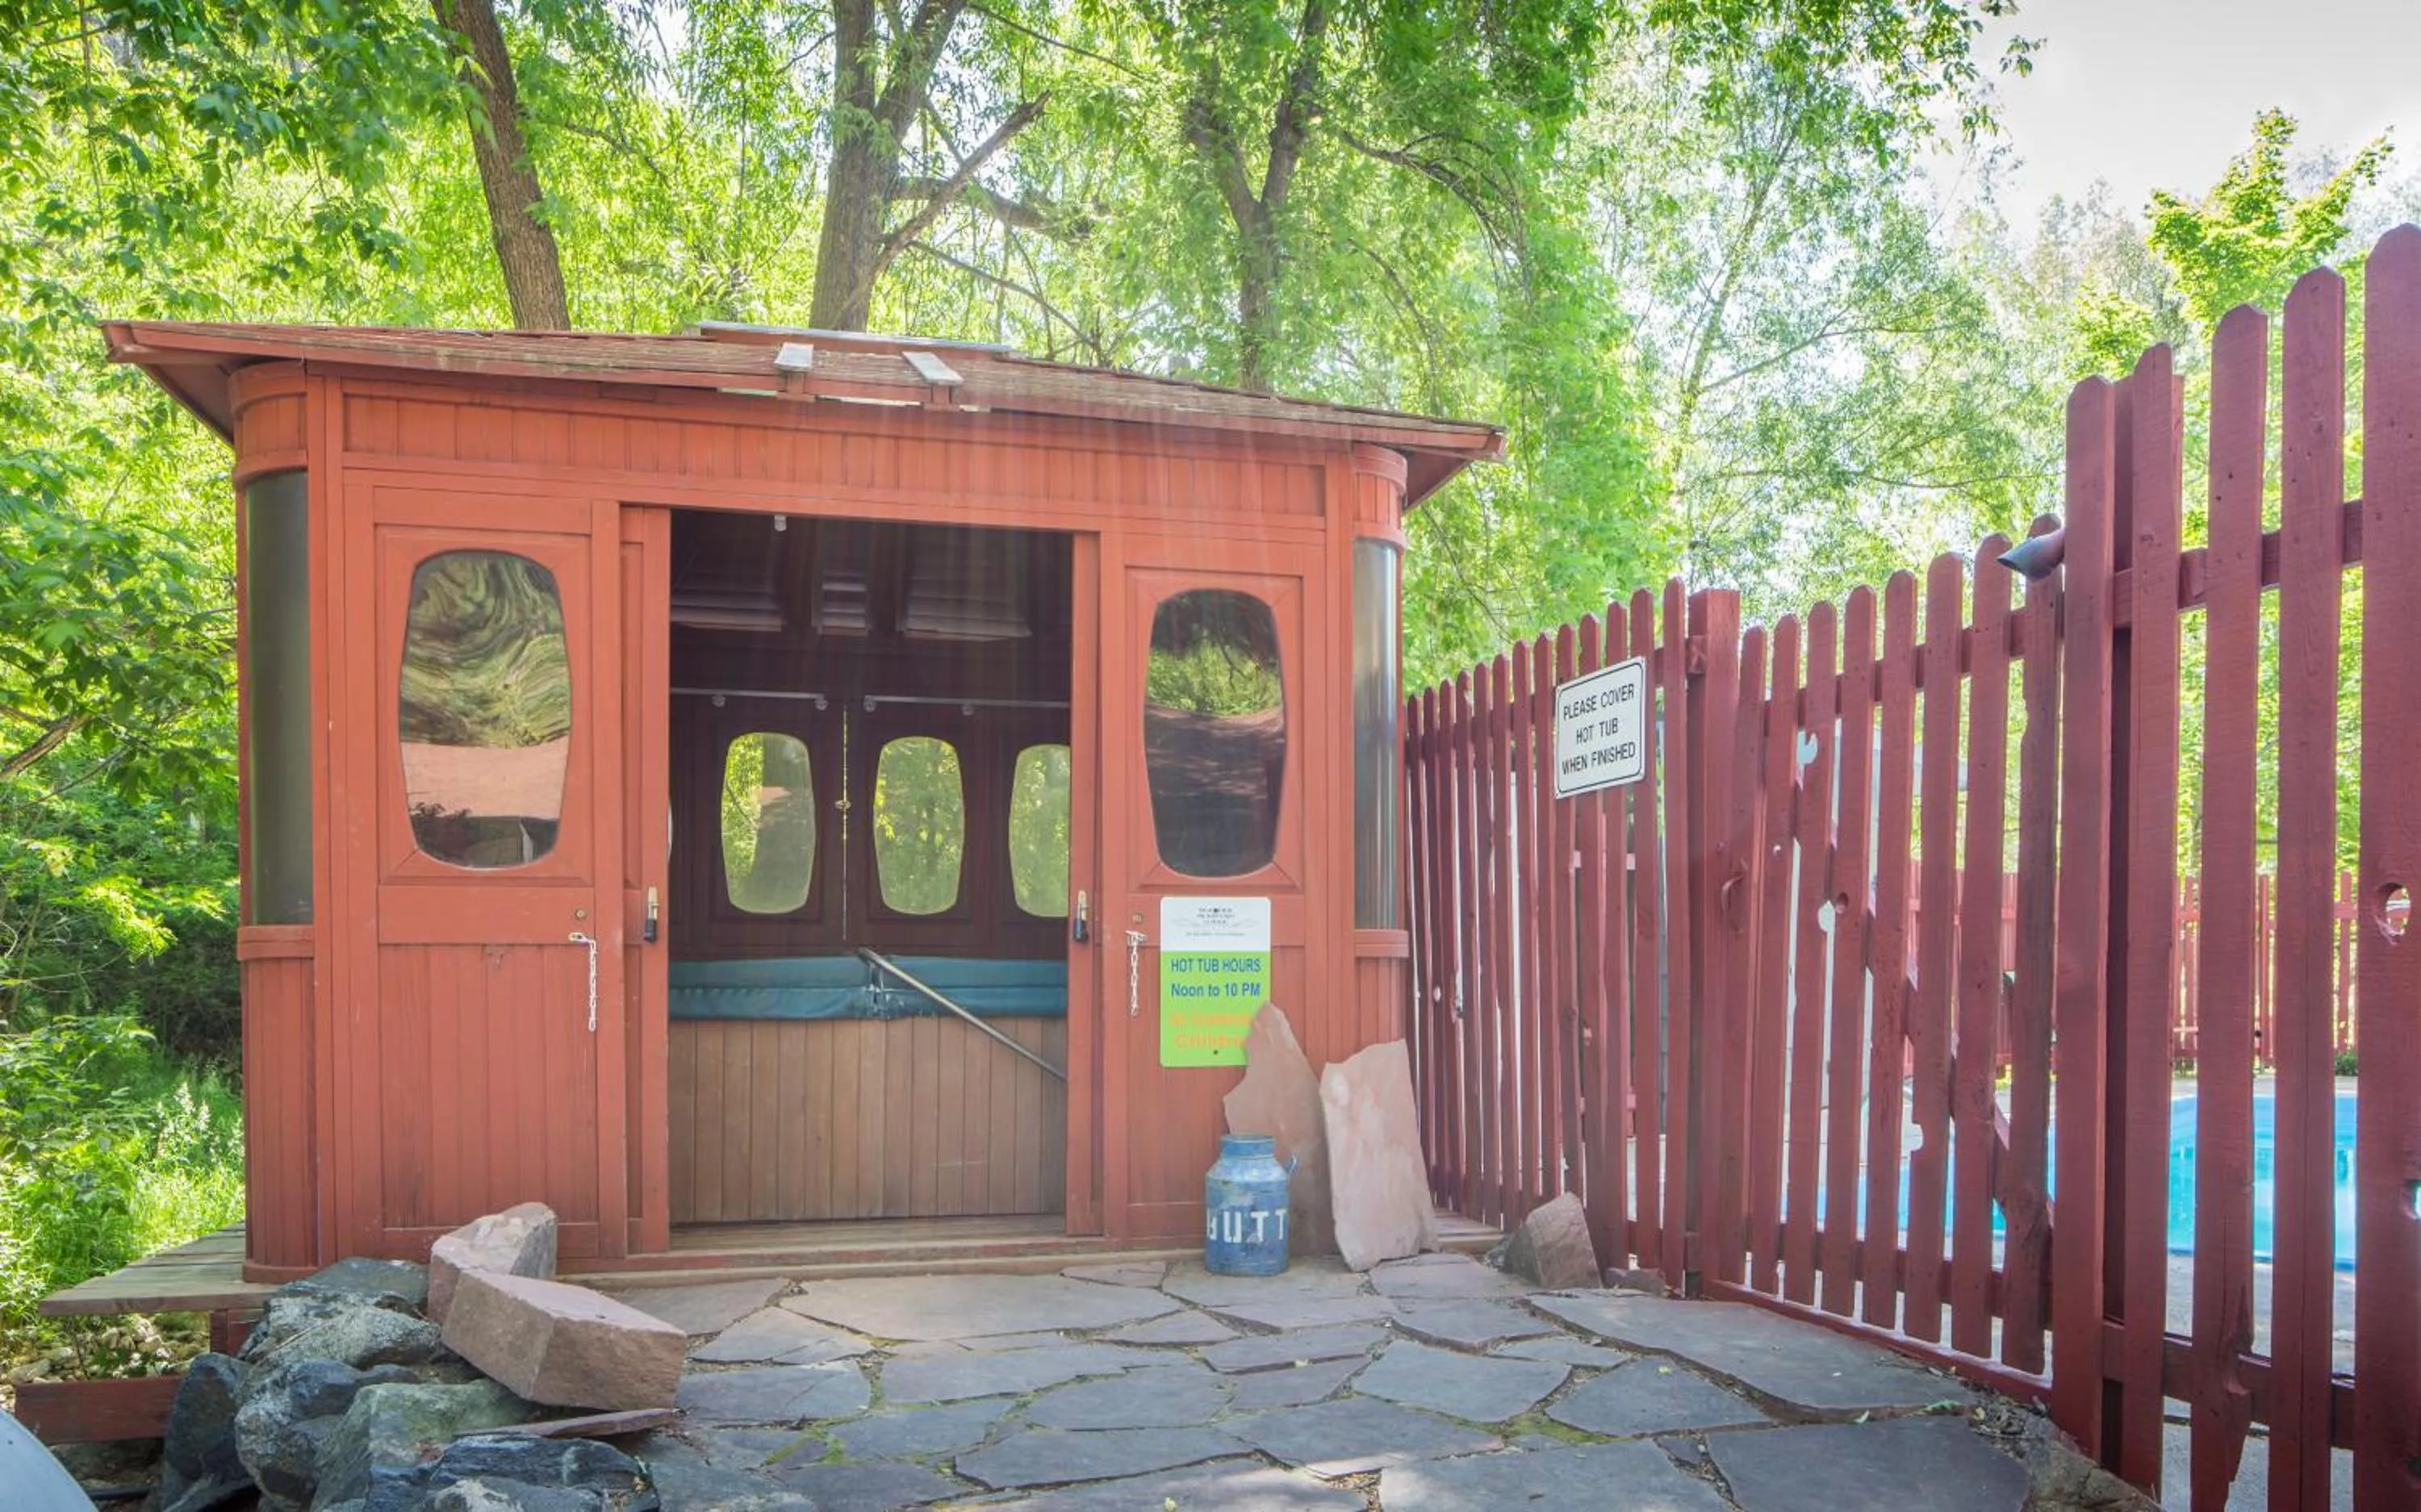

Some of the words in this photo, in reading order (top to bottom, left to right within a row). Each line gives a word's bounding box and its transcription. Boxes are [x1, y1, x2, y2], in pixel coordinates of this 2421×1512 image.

[1563, 695, 1597, 720] PLEASE
[1600, 683, 1635, 708] COVER
[1576, 726, 1594, 745] HOT
[1599, 717, 1619, 737] TUB
[1562, 755, 1588, 775] WHEN
[1591, 741, 1636, 766] FINISHED
[1171, 958, 1193, 972] HOT
[1198, 958, 1219, 972] TUB
[1223, 958, 1261, 972] HOURS
[1171, 984, 1204, 997] Noon
[1208, 984, 1220, 997] to
[1225, 983, 1238, 996] 10
[1242, 982, 1261, 996] PM
